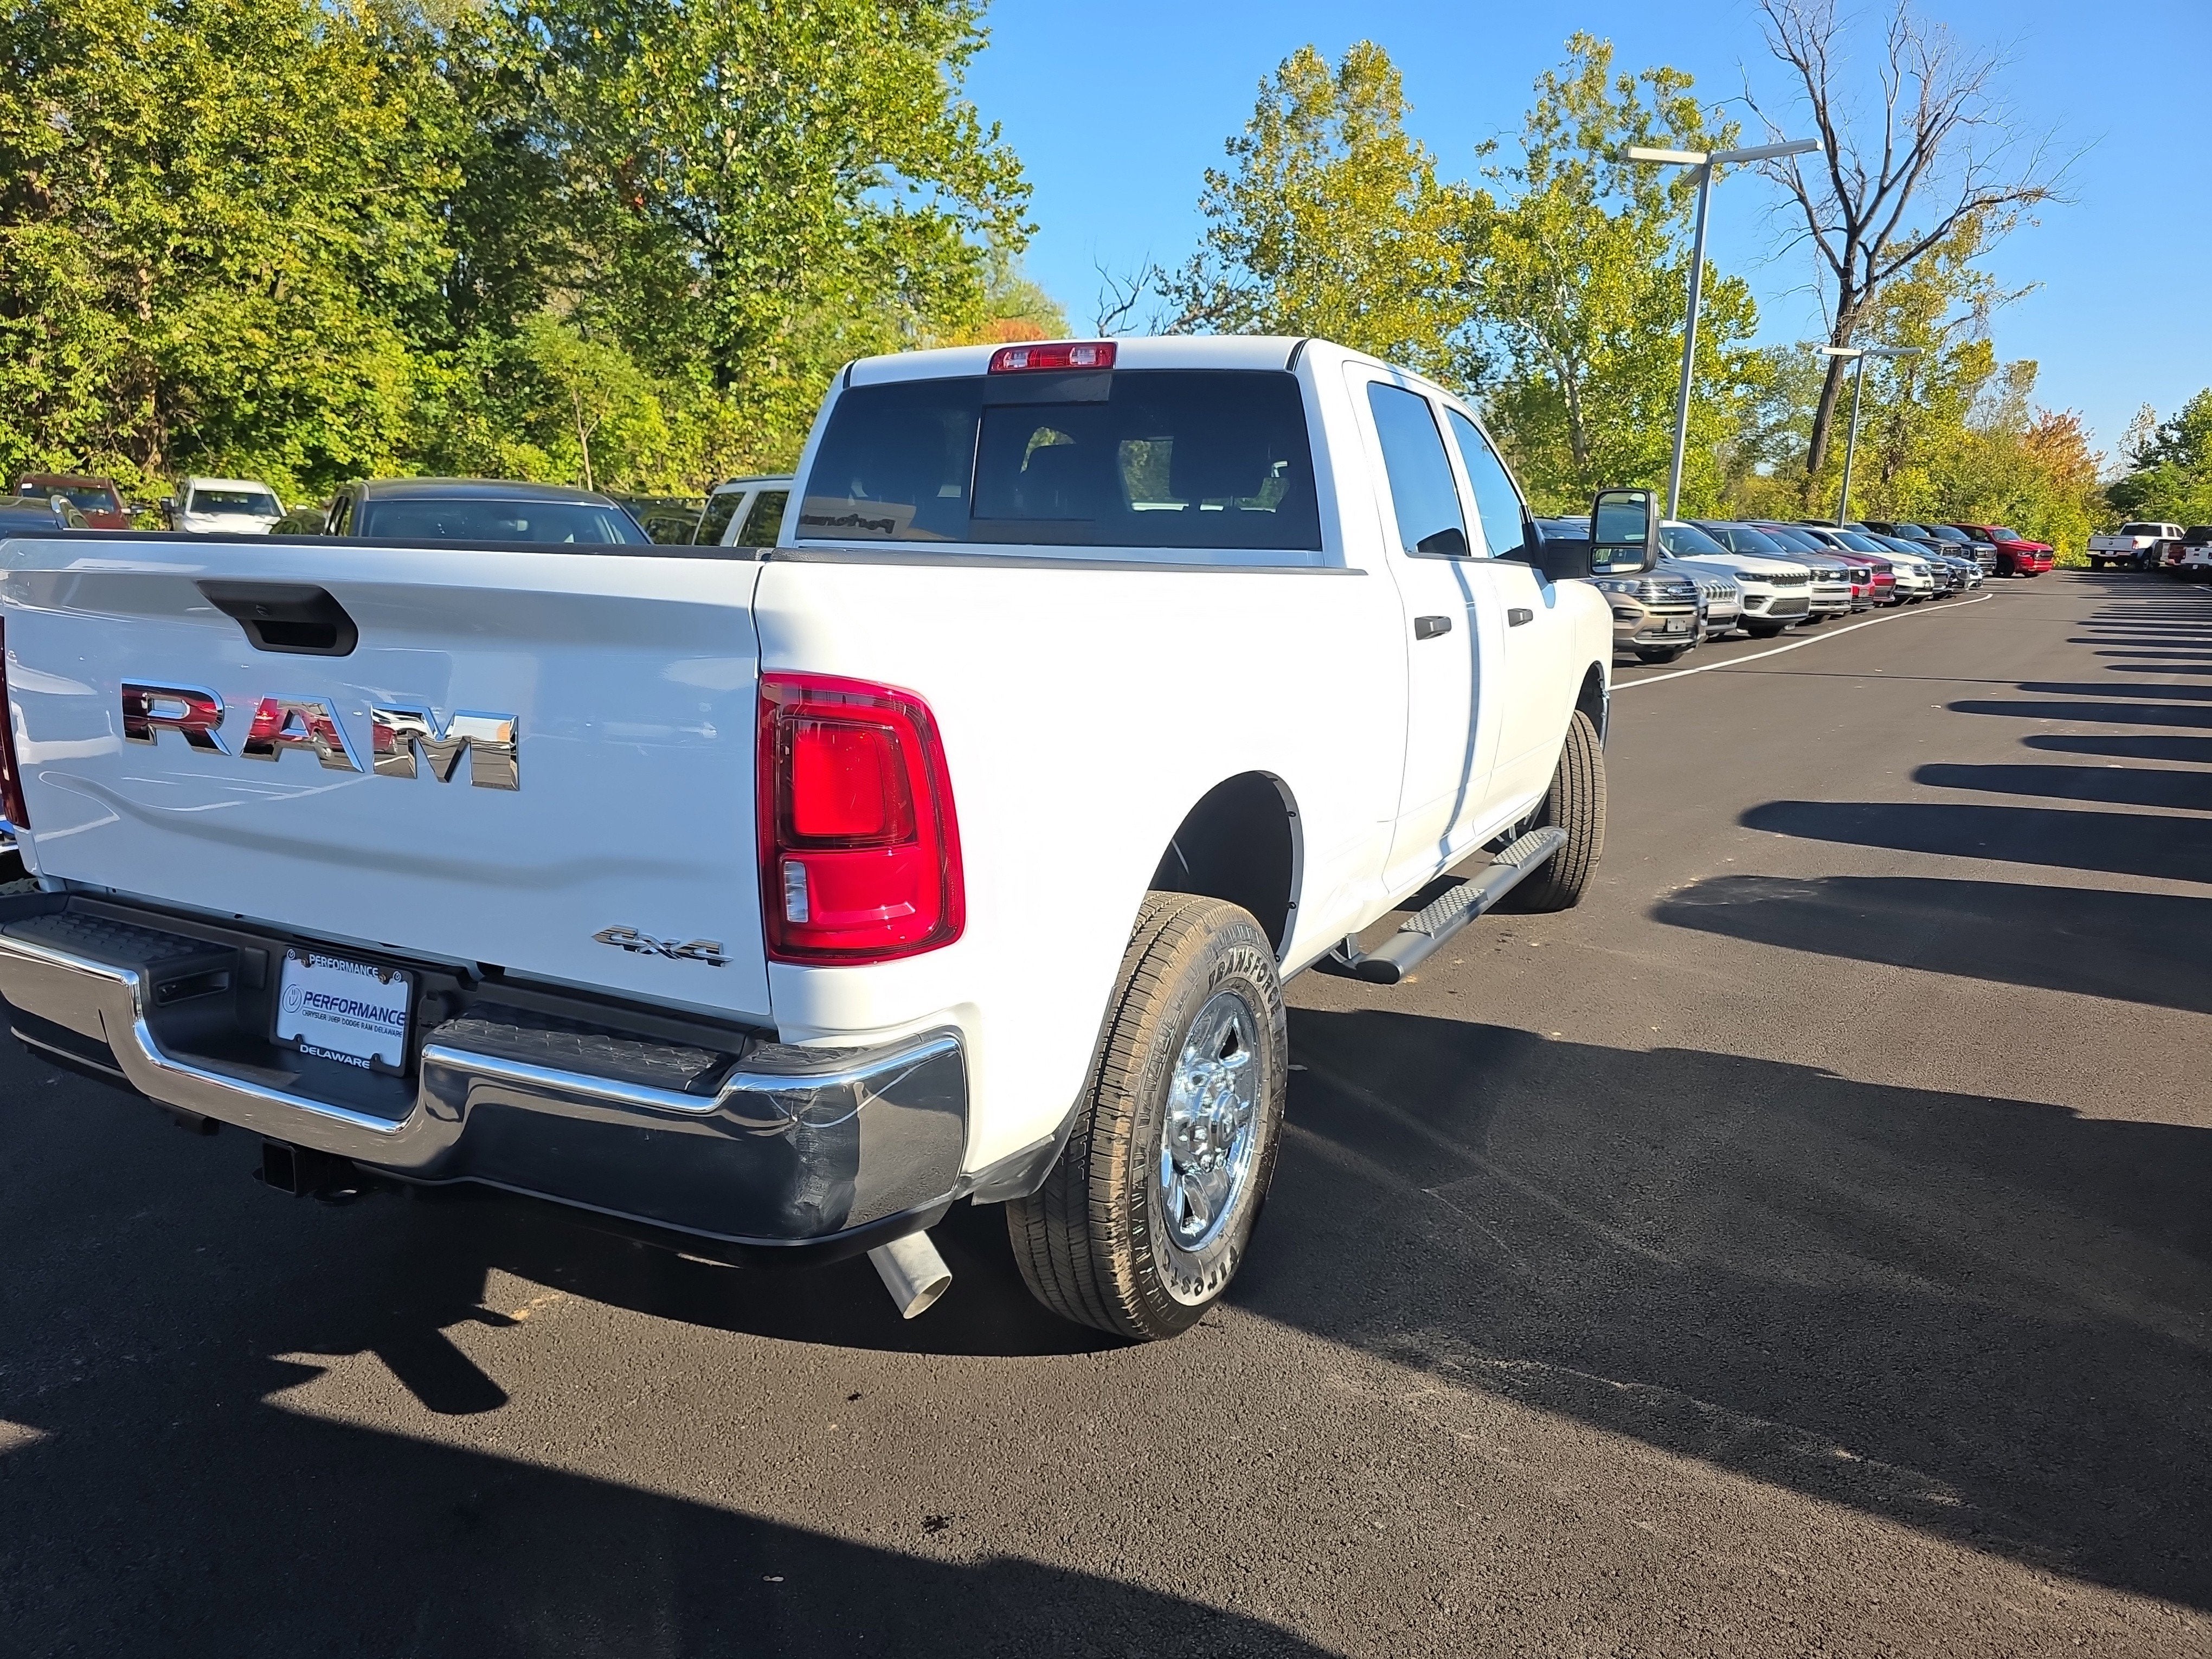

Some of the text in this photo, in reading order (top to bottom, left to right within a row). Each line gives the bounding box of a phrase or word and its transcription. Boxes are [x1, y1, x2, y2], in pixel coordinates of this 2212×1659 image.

[120, 677, 520, 791] RAM
[308, 954, 379, 979] PERFORMANCE
[303, 991, 406, 1026] PERFORMANCE
[302, 1009, 402, 1038] CHRYSLER JEEP DODGE RAM DELAWARE
[300, 1044, 370, 1069] DELAWARE
